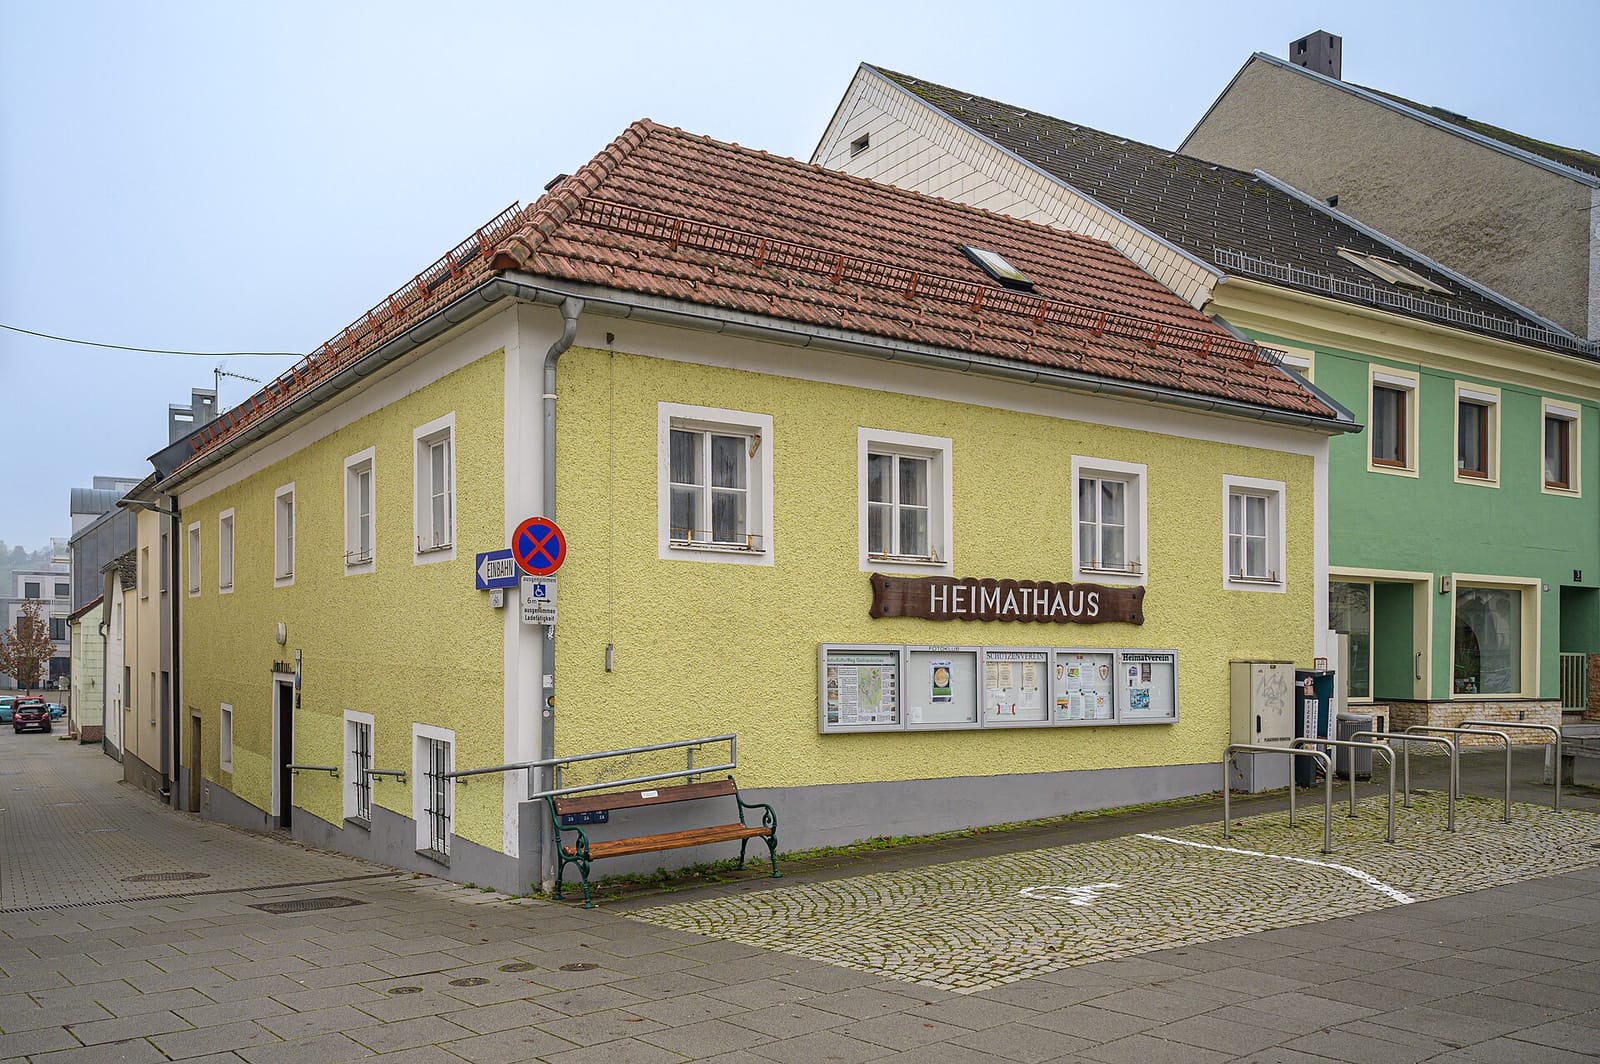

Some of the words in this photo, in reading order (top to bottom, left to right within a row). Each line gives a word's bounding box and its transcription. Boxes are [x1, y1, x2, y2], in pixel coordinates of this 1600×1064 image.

[487, 559, 513, 578] EINBAHN
[930, 584, 1099, 617] HEIMATHAUS
[1122, 654, 1170, 662] Heimatverein
